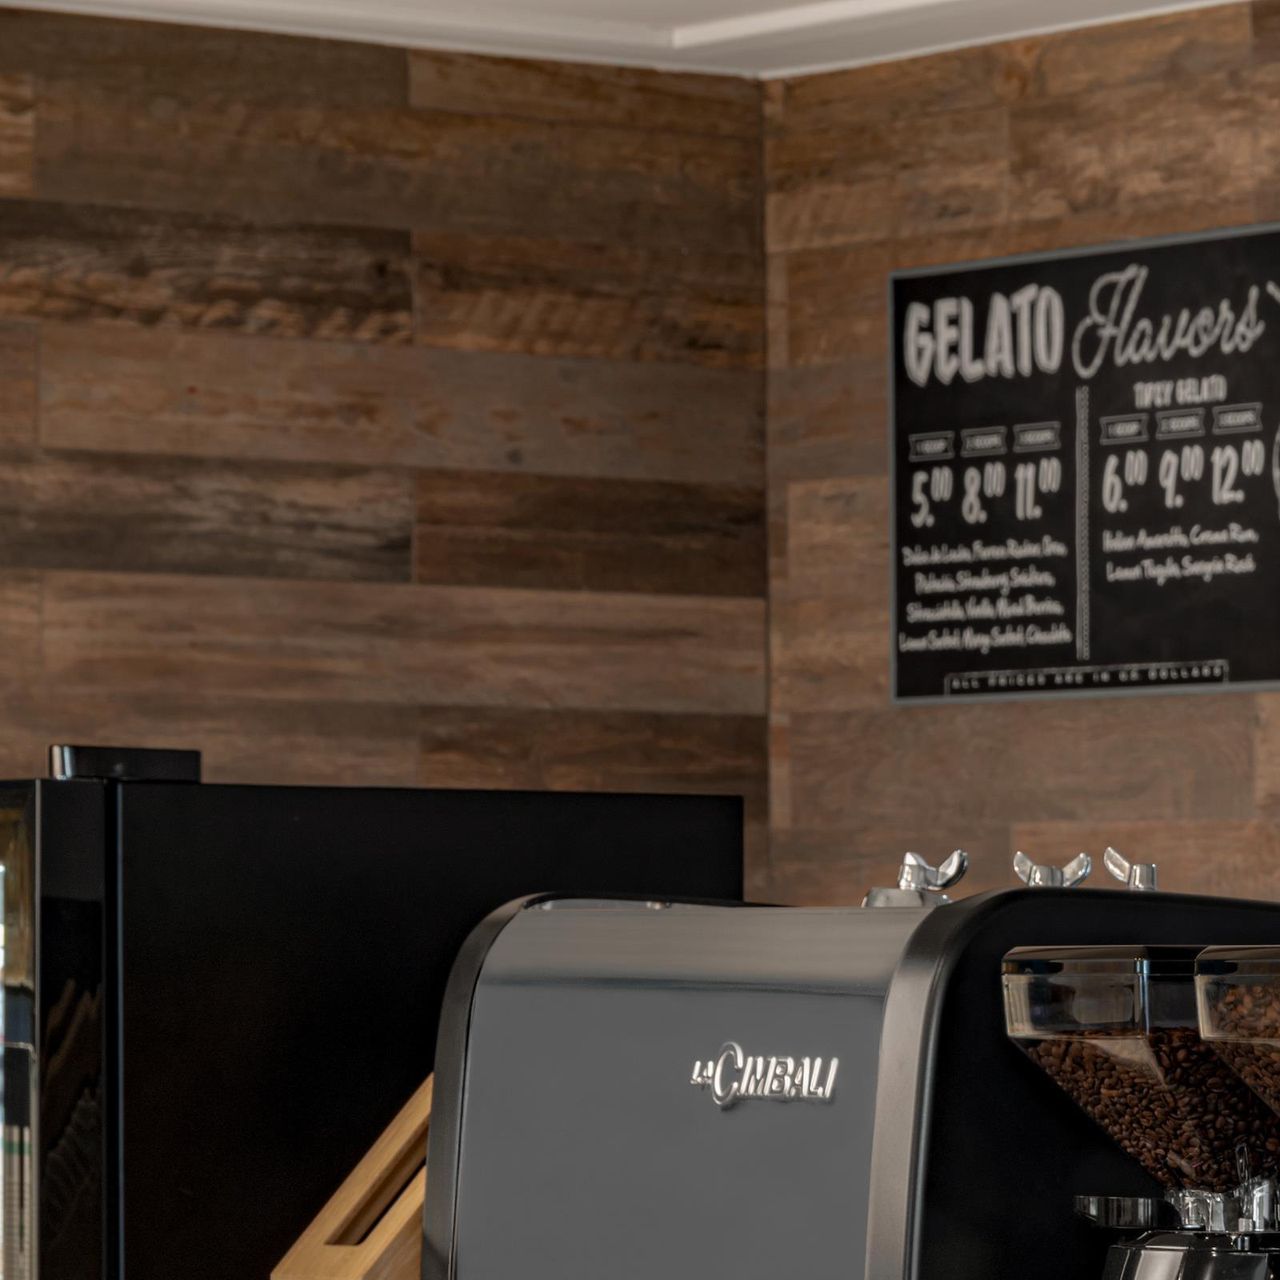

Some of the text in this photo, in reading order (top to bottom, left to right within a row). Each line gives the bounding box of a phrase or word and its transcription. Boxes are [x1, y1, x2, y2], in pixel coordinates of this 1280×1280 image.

[904, 264, 1266, 386] GELATO Flavors
[1175, 374, 1227, 405] GELATO
[712, 1041, 839, 1105] CIMBALI
